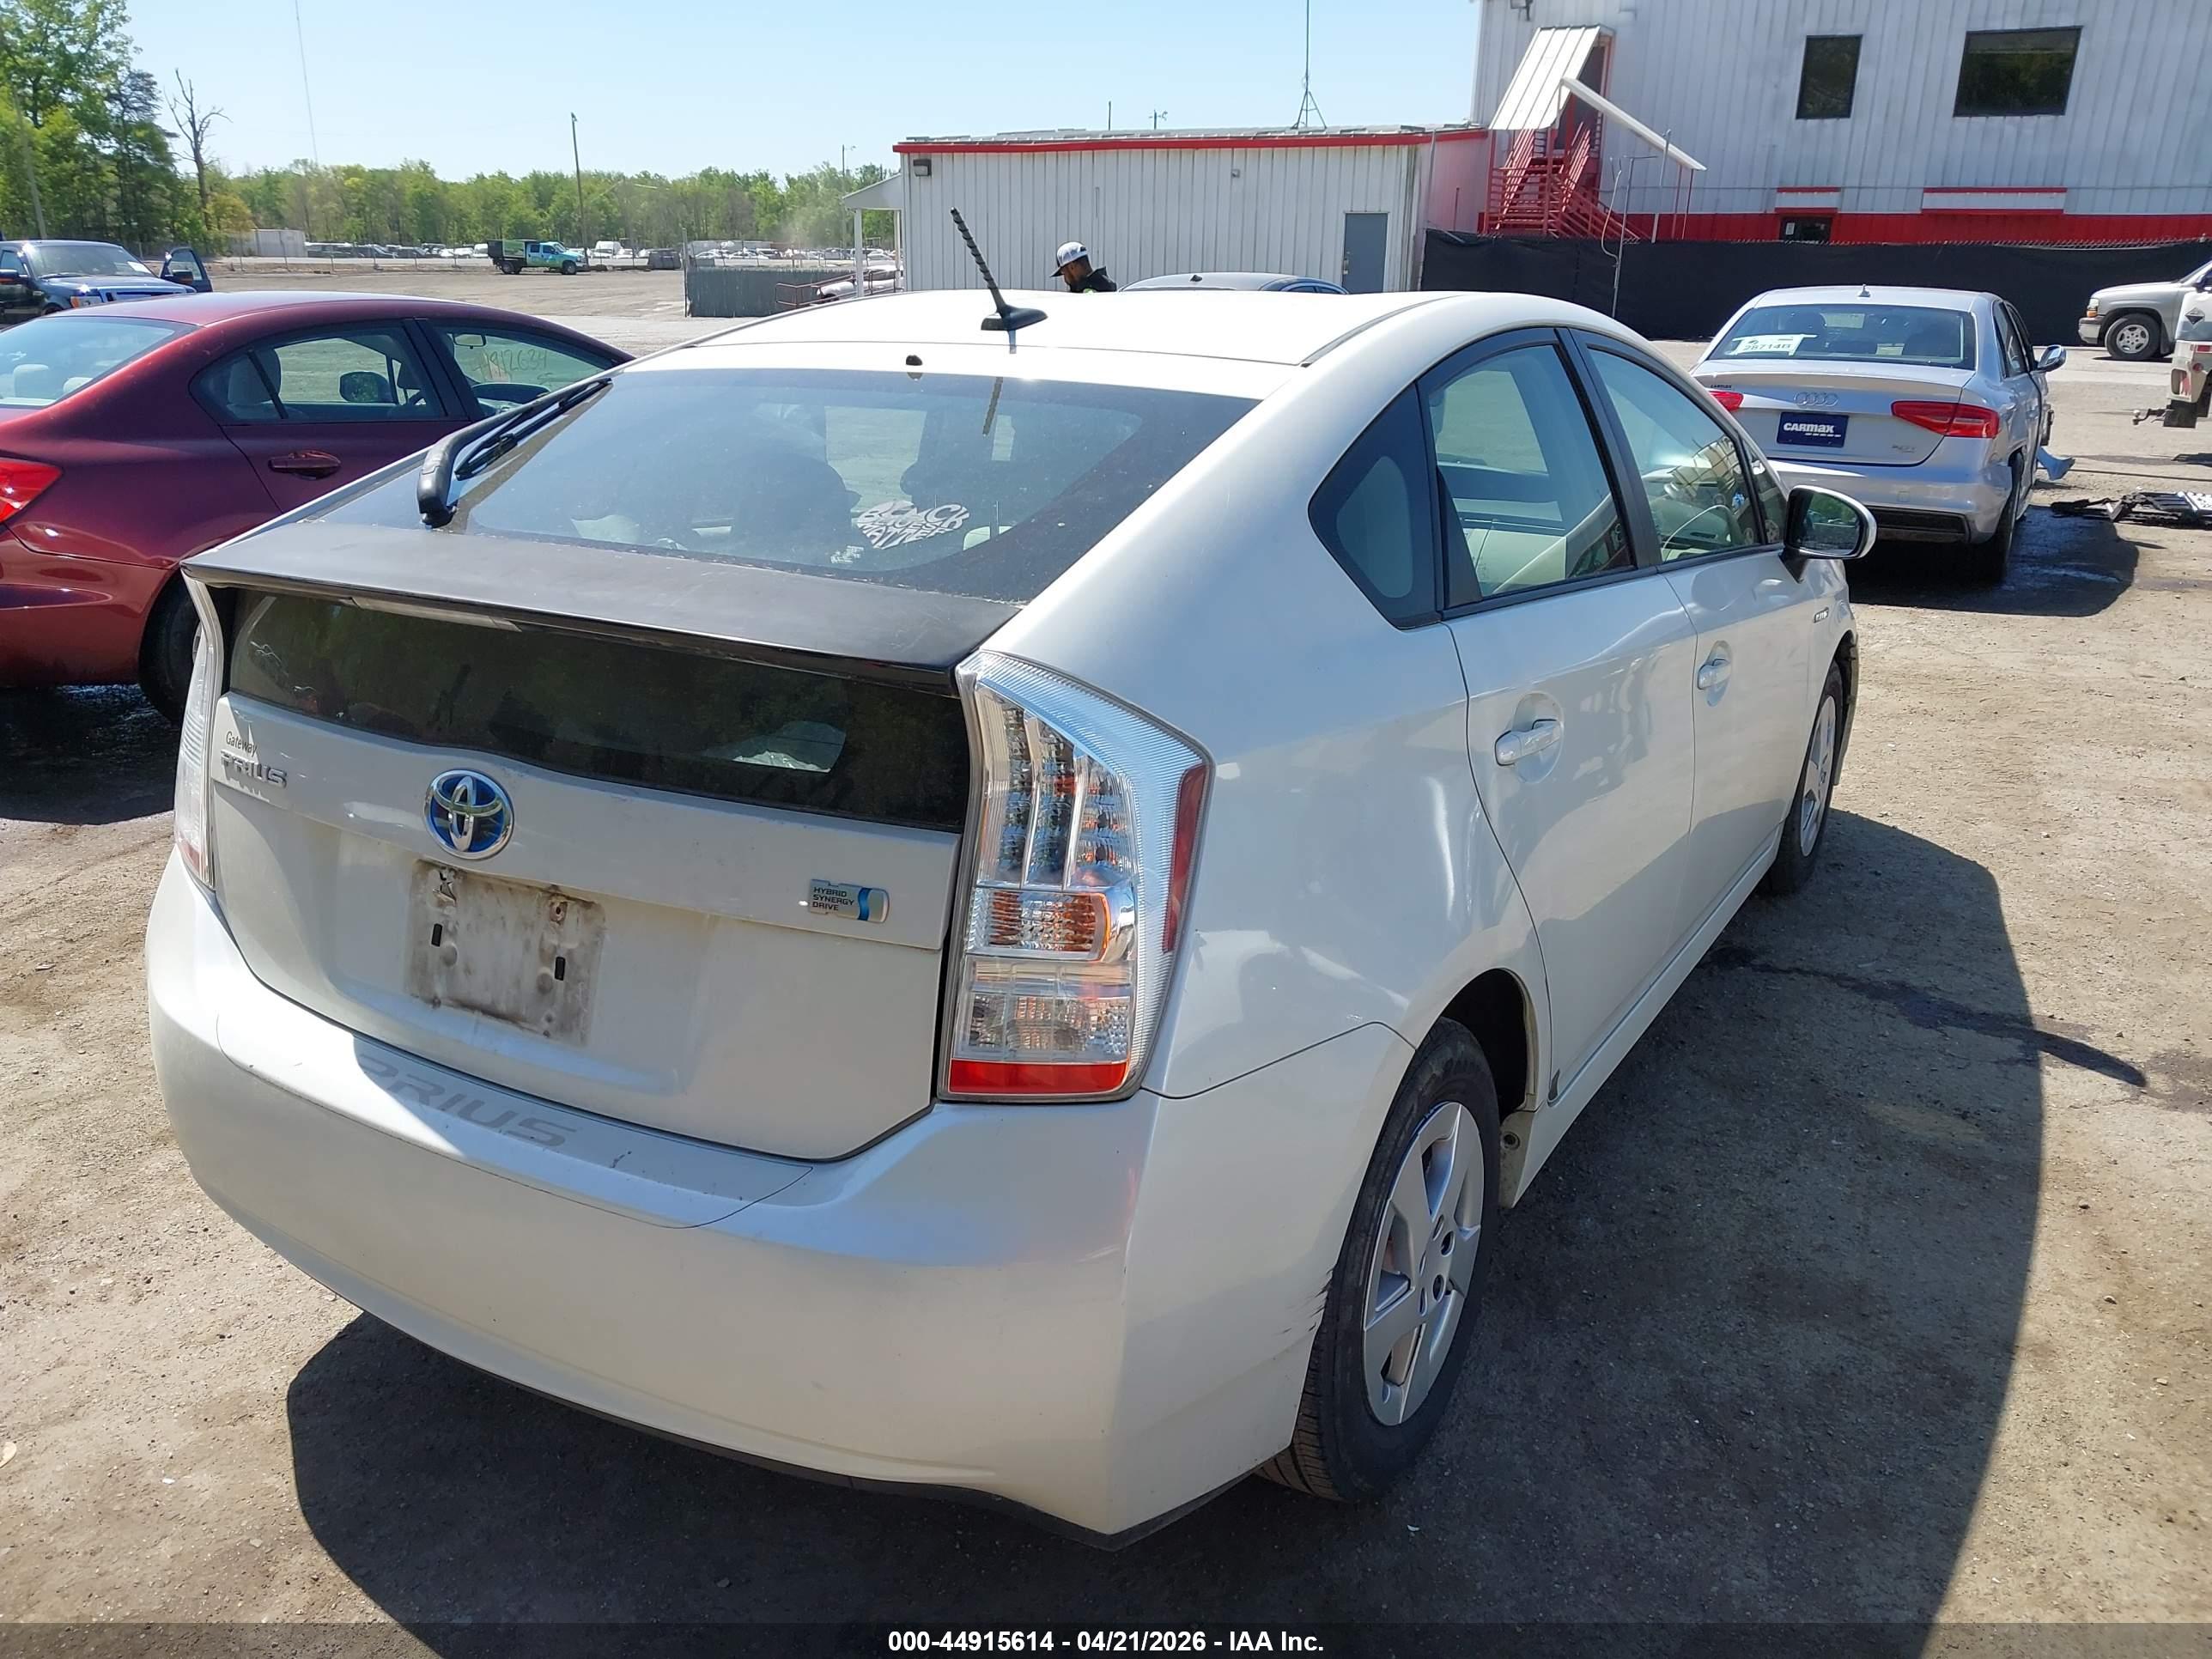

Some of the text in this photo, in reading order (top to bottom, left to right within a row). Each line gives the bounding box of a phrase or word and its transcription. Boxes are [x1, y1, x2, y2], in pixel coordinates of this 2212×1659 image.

[226, 731, 258, 757] Gateway
[221, 749, 287, 788] PRIUS
[813, 887, 847, 897] HYBRID
[813, 894, 855, 906] SYNERGY
[812, 901, 839, 911] DRIVE
[359, 1054, 577, 1146] PRIUS
